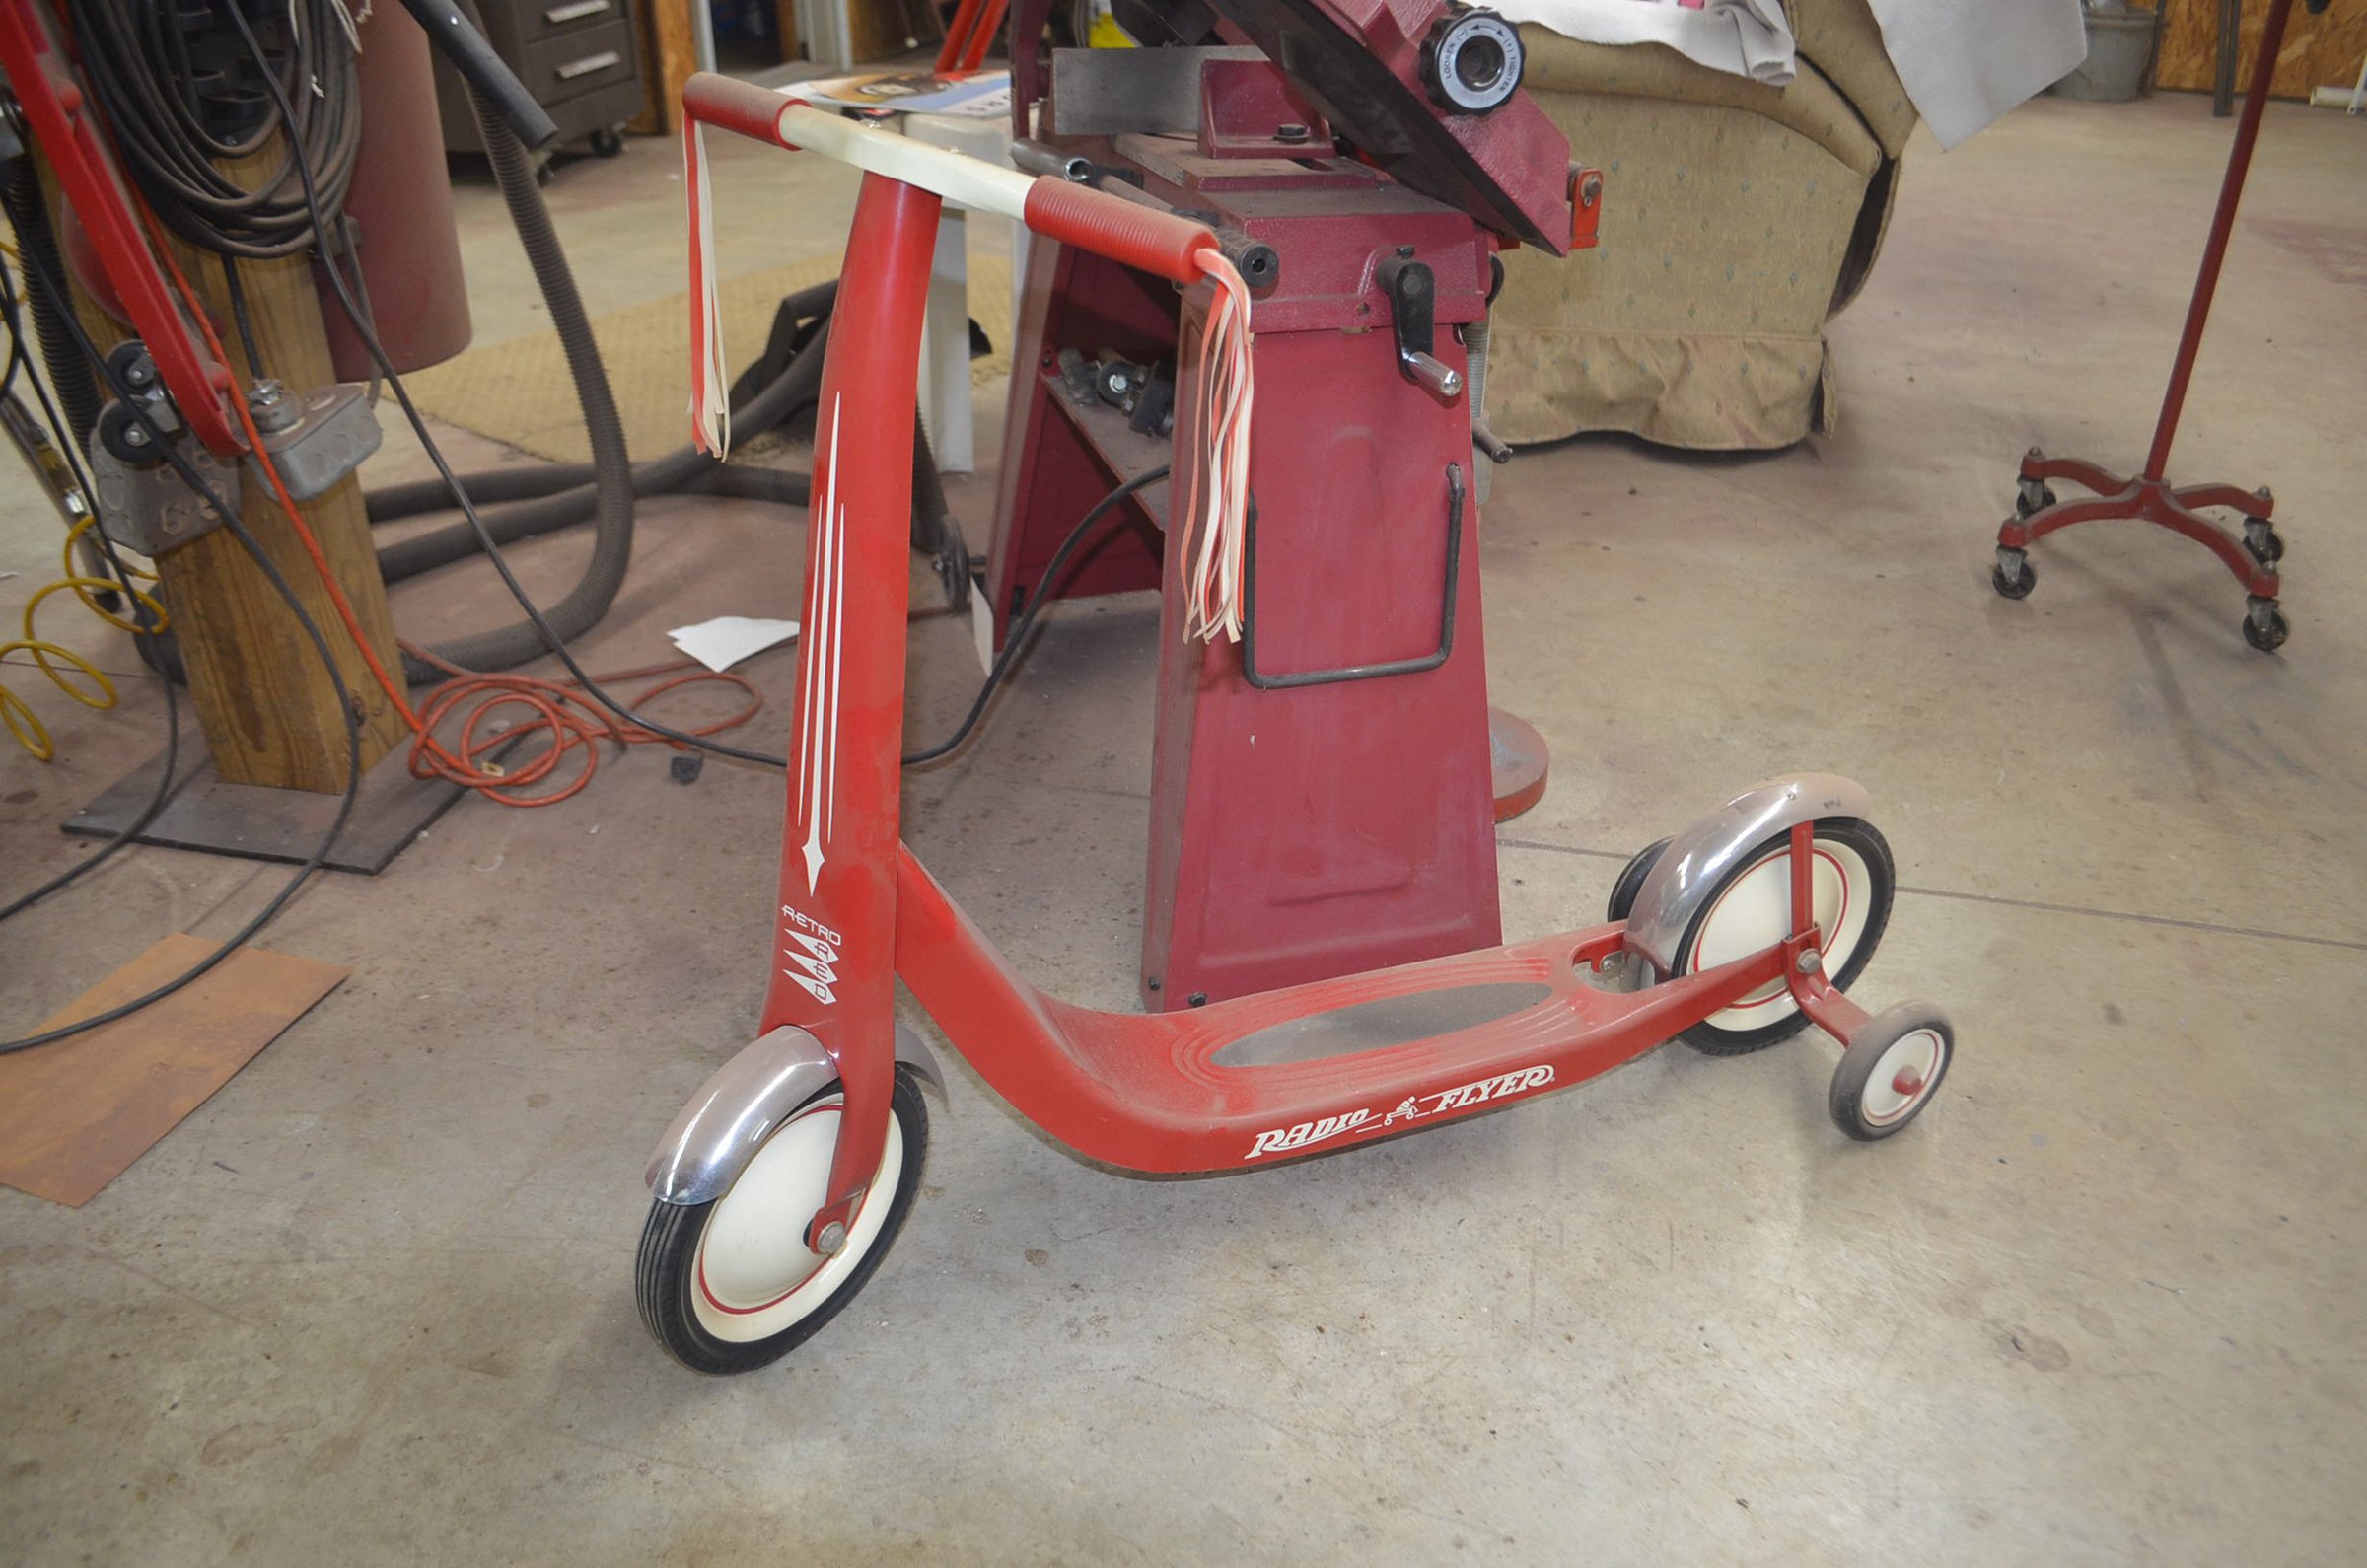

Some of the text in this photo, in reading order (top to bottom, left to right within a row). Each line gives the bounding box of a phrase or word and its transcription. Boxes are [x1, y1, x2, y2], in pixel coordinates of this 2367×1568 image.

[1443, 42, 1456, 79] LOOSEN
[1499, 56, 1516, 91] TIGHTEN
[781, 904, 842, 946] RETRO
[1243, 1064, 1555, 1160] RADIO FLYER
